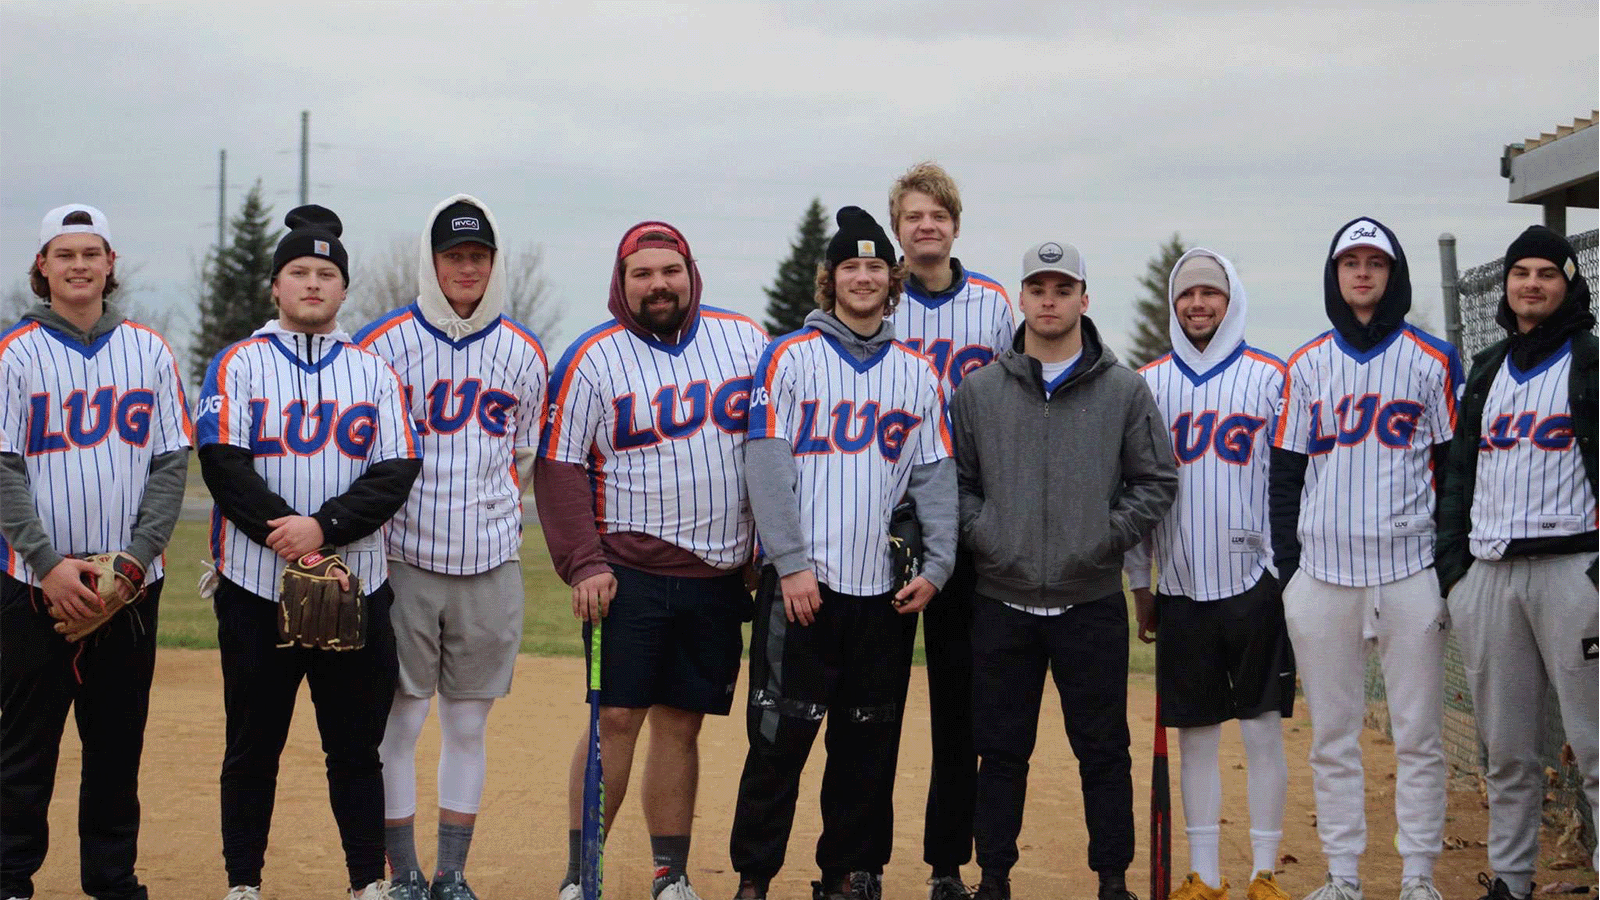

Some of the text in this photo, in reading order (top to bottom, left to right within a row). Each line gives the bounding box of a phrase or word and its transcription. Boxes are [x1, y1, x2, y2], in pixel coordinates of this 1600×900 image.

[1350, 227, 1377, 240] Bad
[26, 385, 154, 457] LUG
[612, 376, 753, 452] LUG
[750, 386, 769, 409] UG
[1307, 393, 1425, 457] LUG
[250, 398, 377, 461] LUG
[794, 399, 922, 463] LUG
[1171, 410, 1268, 467] UG
